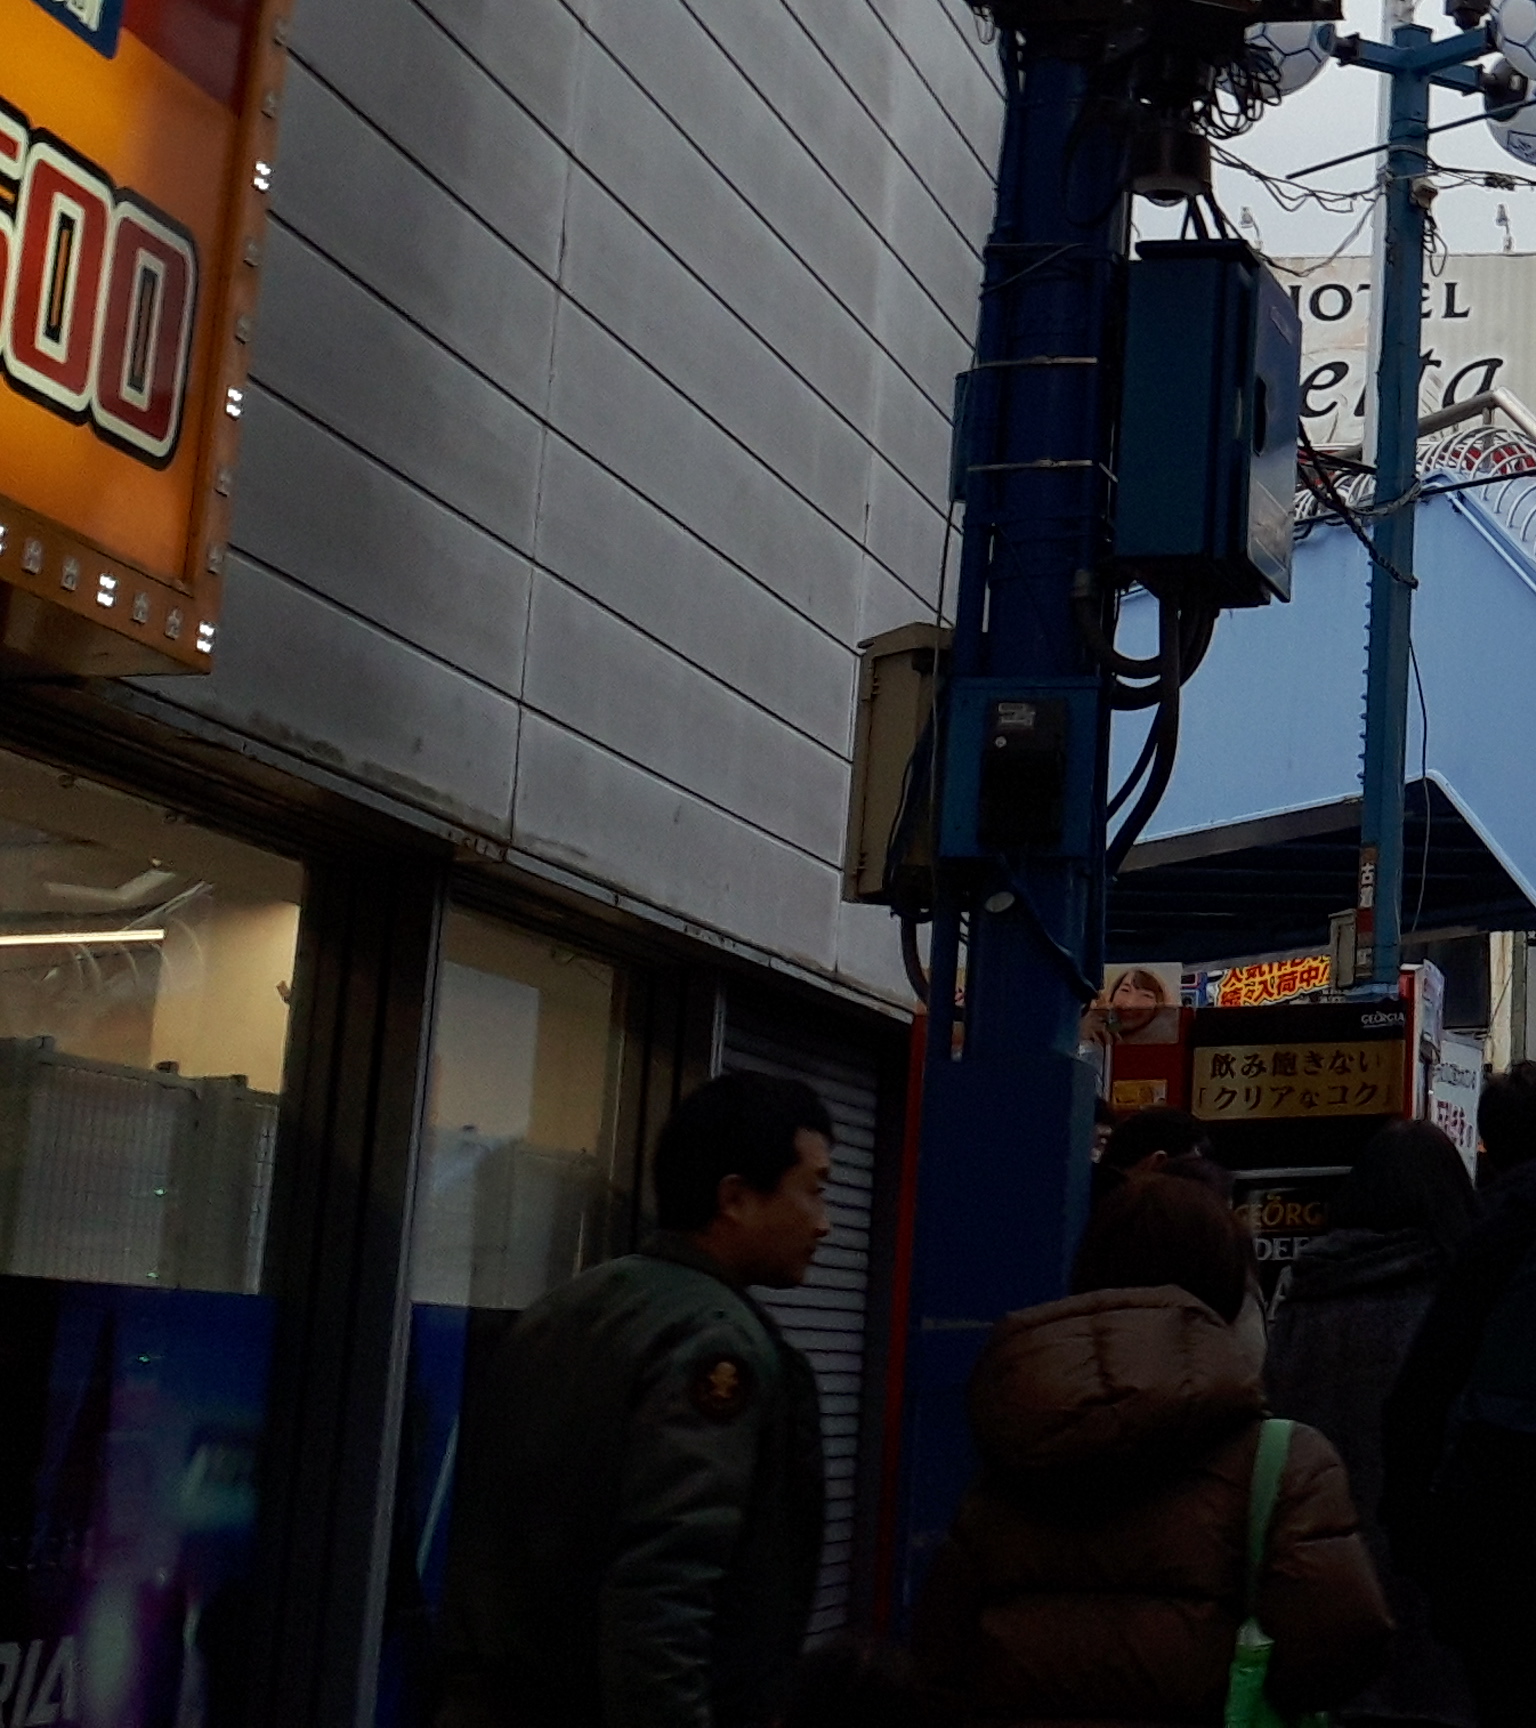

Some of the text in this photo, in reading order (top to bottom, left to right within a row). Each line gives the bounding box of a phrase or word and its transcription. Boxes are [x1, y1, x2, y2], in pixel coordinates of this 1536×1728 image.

[1211, 1050, 1381, 1080] 飲み飽きない
